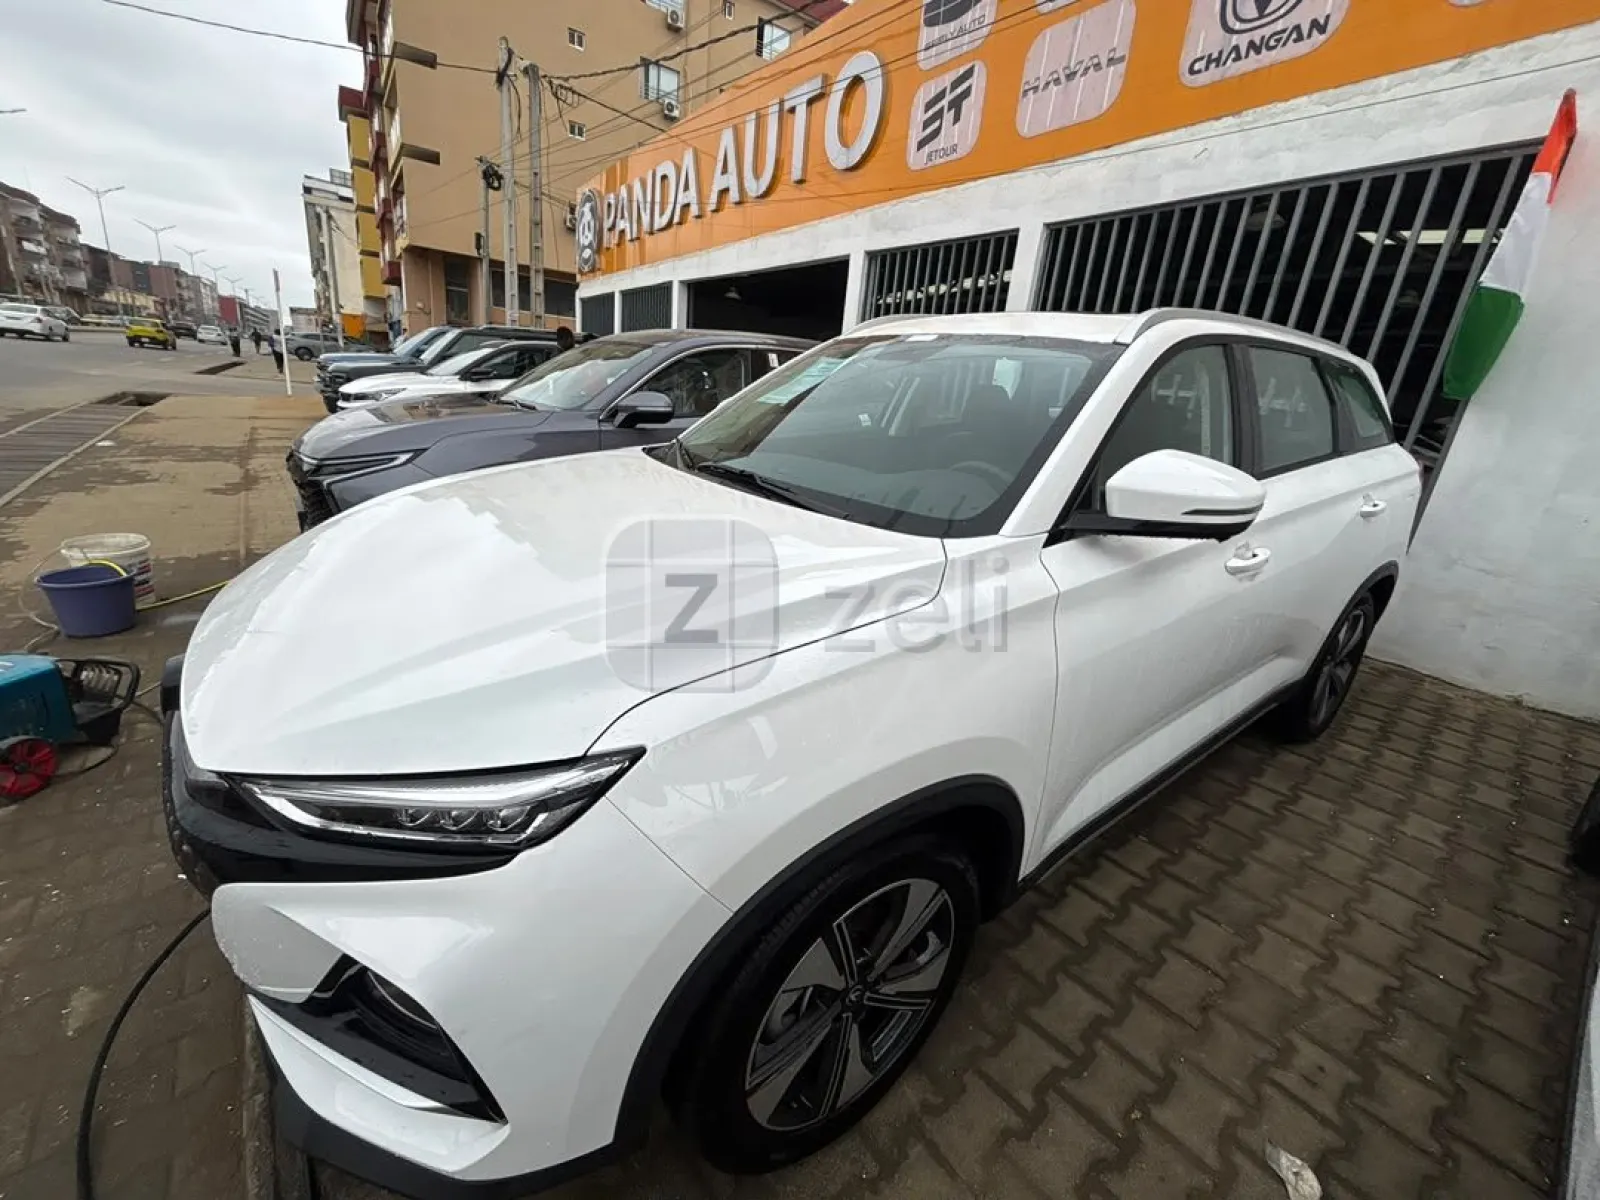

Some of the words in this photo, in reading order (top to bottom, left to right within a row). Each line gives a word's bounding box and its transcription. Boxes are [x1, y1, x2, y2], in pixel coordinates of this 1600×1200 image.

[1021, 47, 1126, 98] HAVAL
[1188, 13, 1331, 76] CHANGAN
[602, 147, 702, 250] PANDA
[708, 50, 885, 213] AUTO
[924, 144, 959, 166] JETOUR
